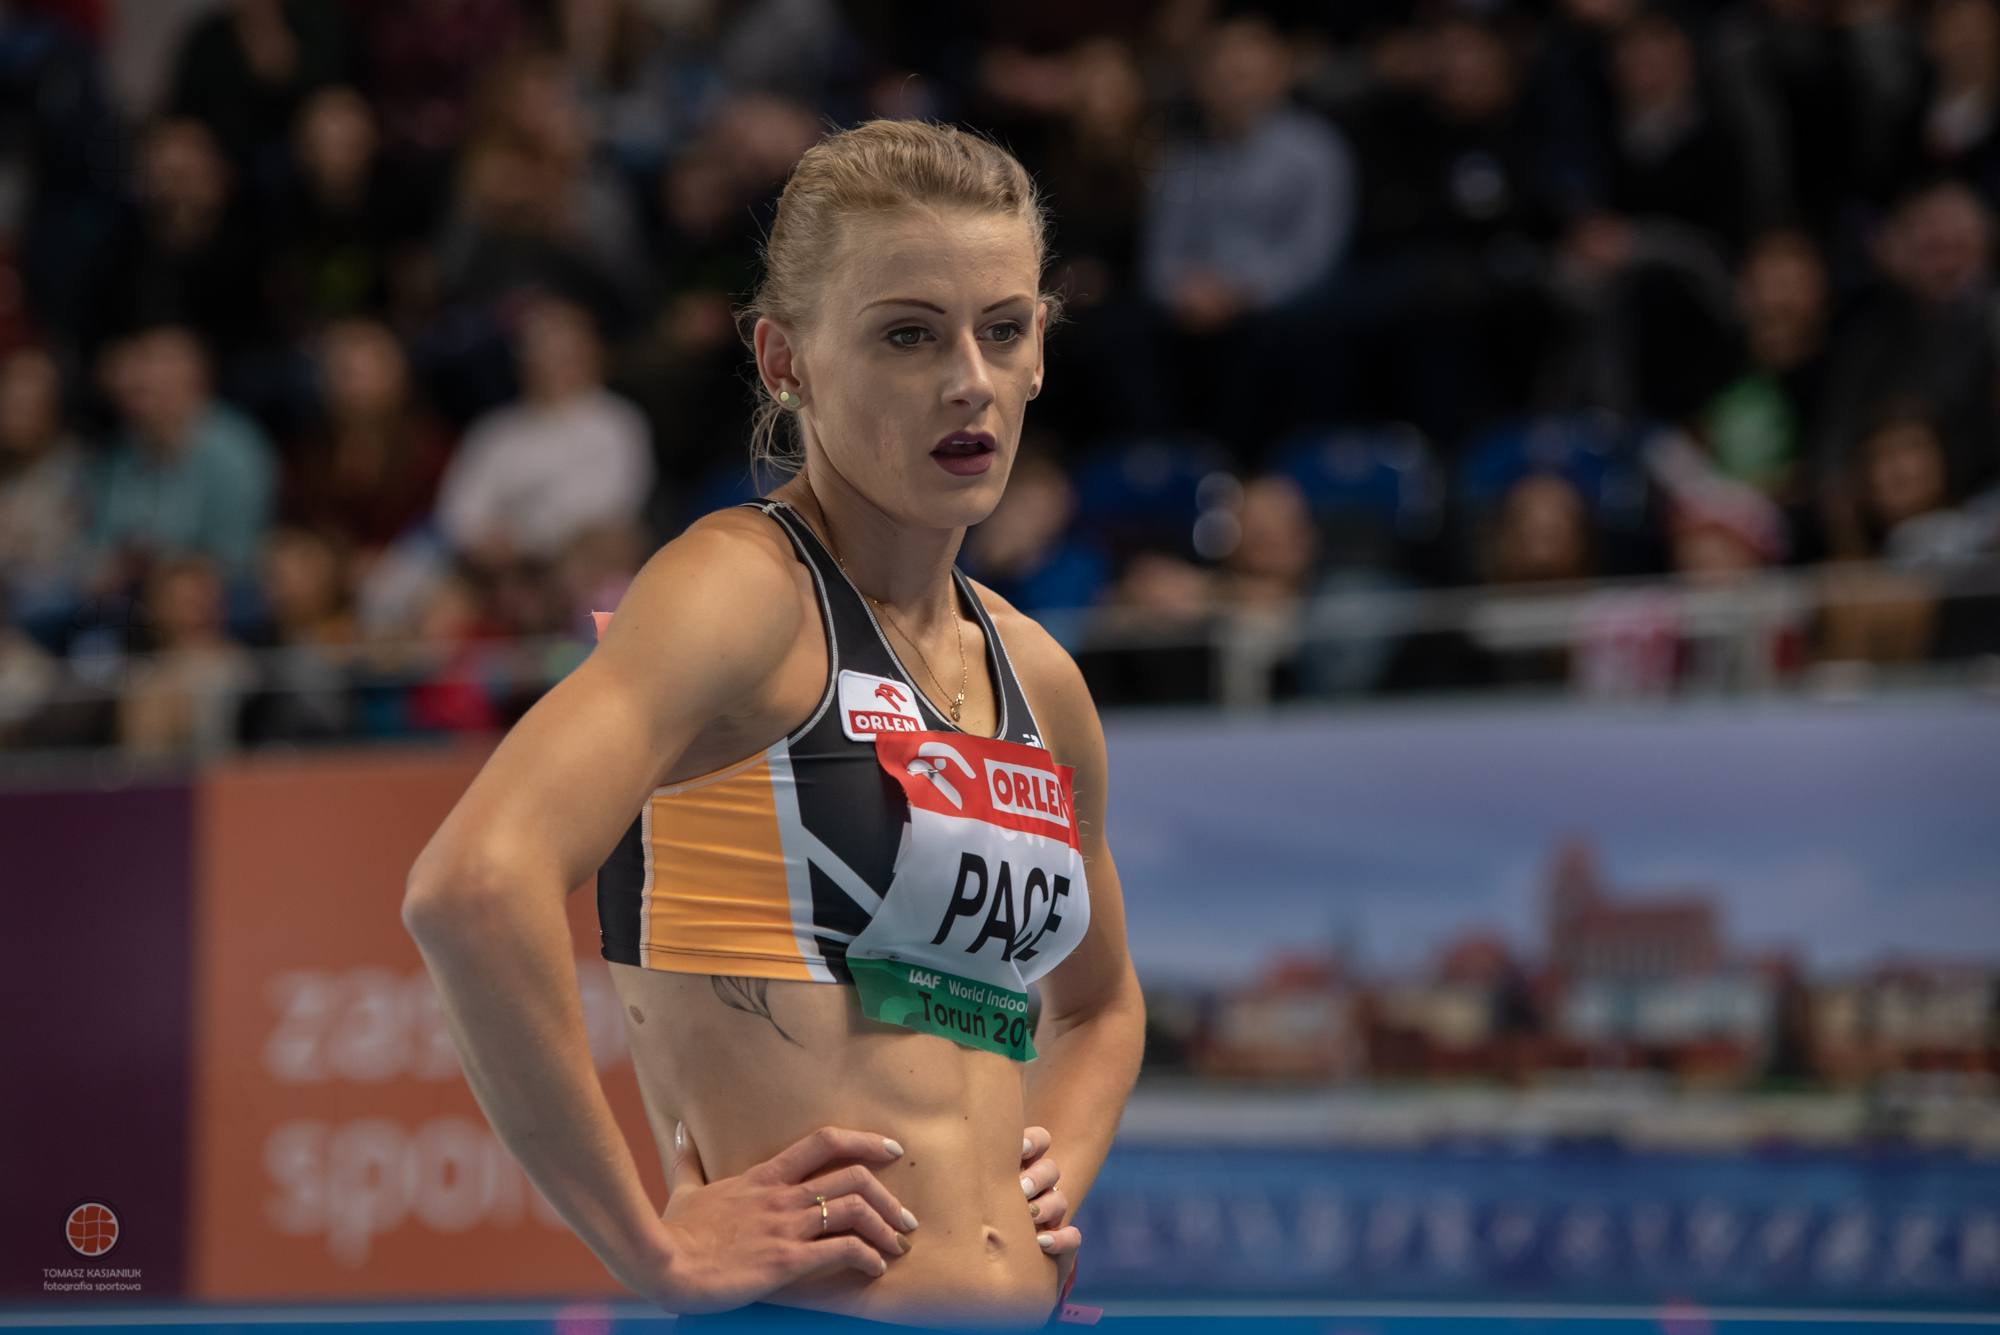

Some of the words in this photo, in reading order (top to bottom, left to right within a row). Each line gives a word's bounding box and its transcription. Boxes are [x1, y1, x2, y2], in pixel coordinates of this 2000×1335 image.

[855, 714, 916, 732] ORLEN
[930, 851, 1071, 963] PACE
[908, 969, 943, 990] IAAF
[949, 979, 984, 1004] World
[917, 990, 987, 1039] Toruń
[992, 1012, 1027, 1050] 20
